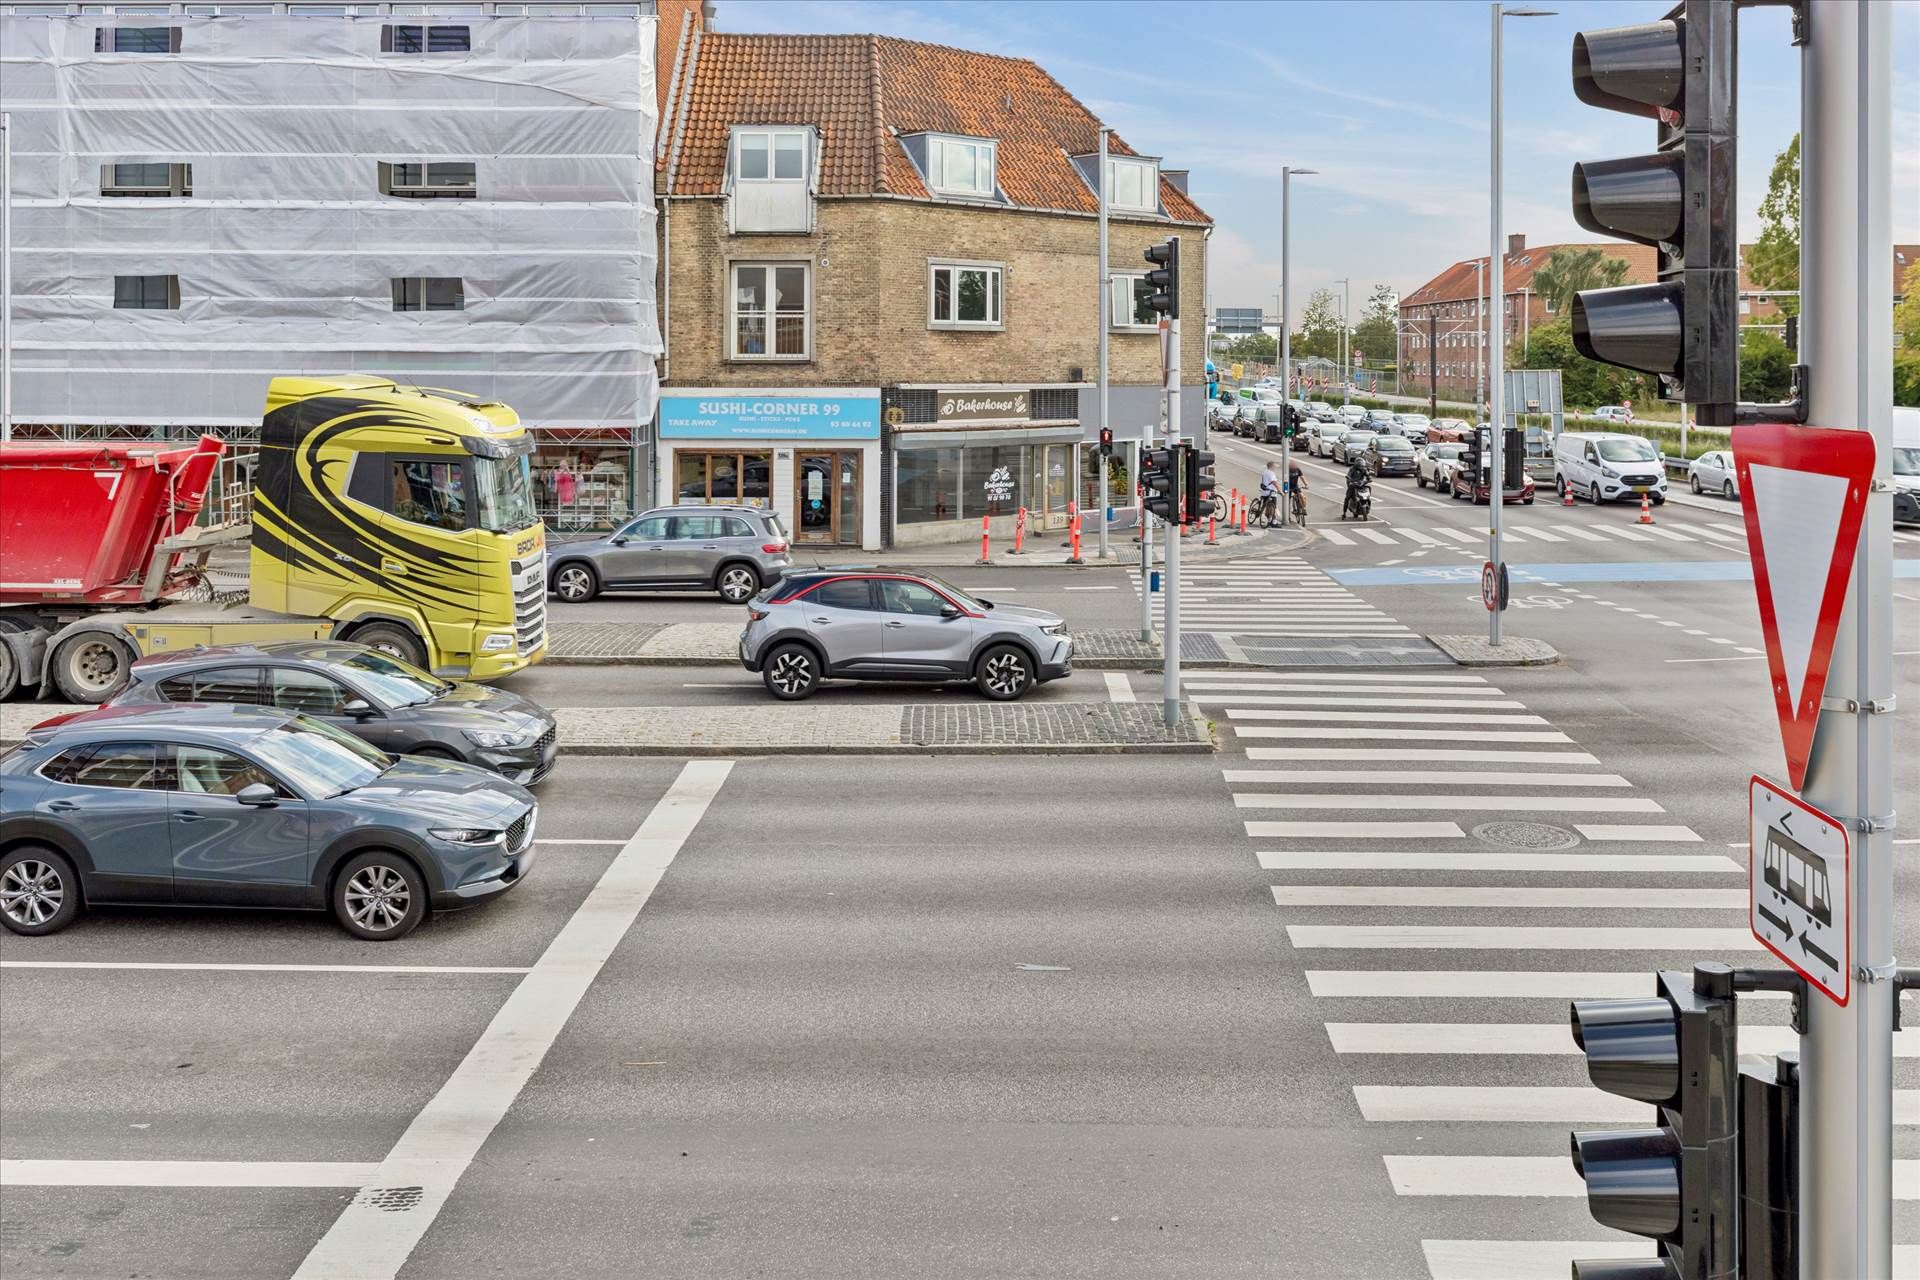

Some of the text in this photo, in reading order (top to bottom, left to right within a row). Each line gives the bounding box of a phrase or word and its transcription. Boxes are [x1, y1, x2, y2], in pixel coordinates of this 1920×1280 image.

[699, 402, 841, 416] SUSHI-CORNER 99
[956, 398, 1013, 413] Bakerhouse
[527, 571, 540, 585] DAF
